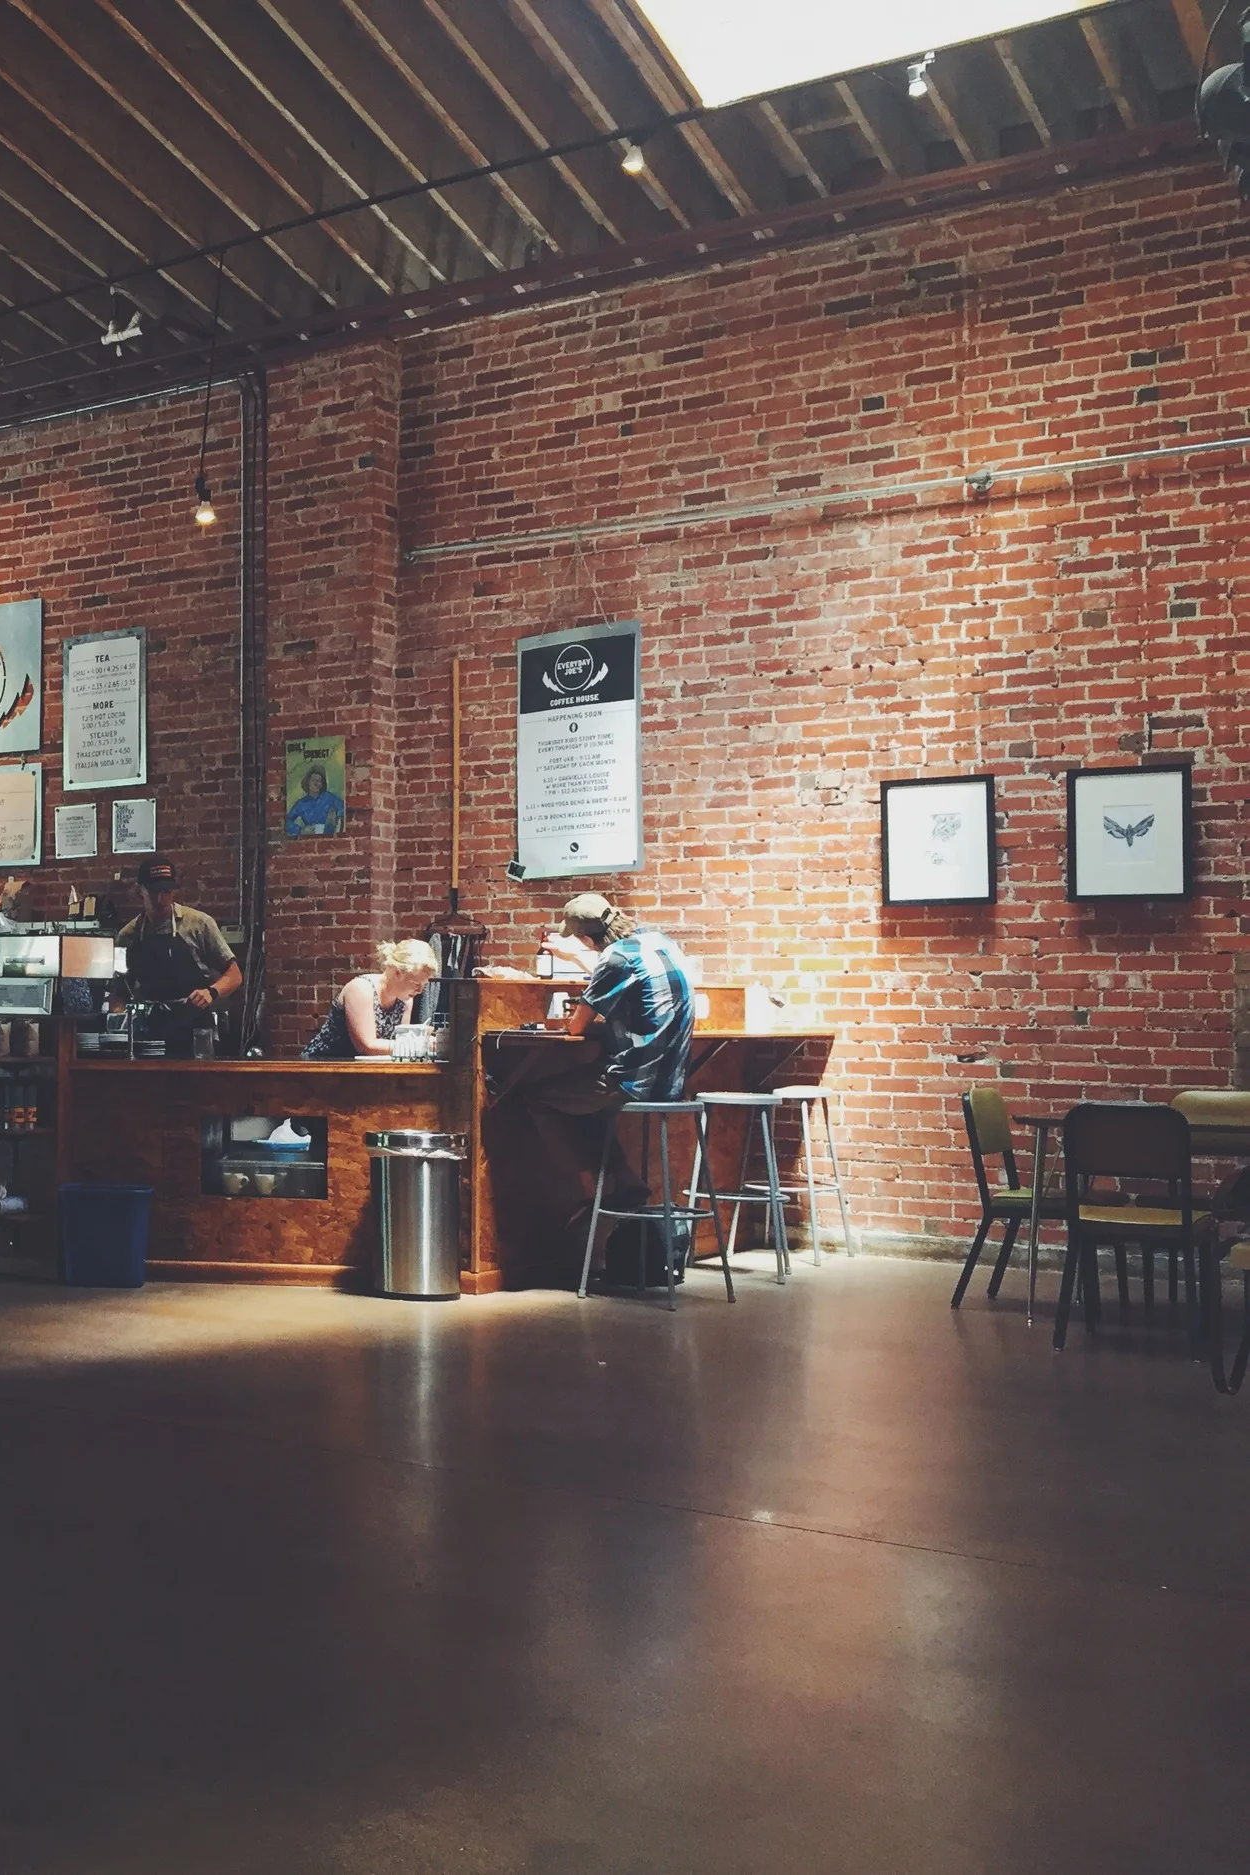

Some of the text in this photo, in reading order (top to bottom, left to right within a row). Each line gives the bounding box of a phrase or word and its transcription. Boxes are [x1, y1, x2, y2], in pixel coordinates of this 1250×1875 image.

[95, 654, 110, 663] TEA
[557, 658, 590, 670] EVERYDAY
[564, 666, 583, 675] JOE'S
[93, 700, 114, 710] MORE
[550, 694, 599, 706] COFFEE HOUSE
[548, 710, 602, 722] HAPPENING SOON
